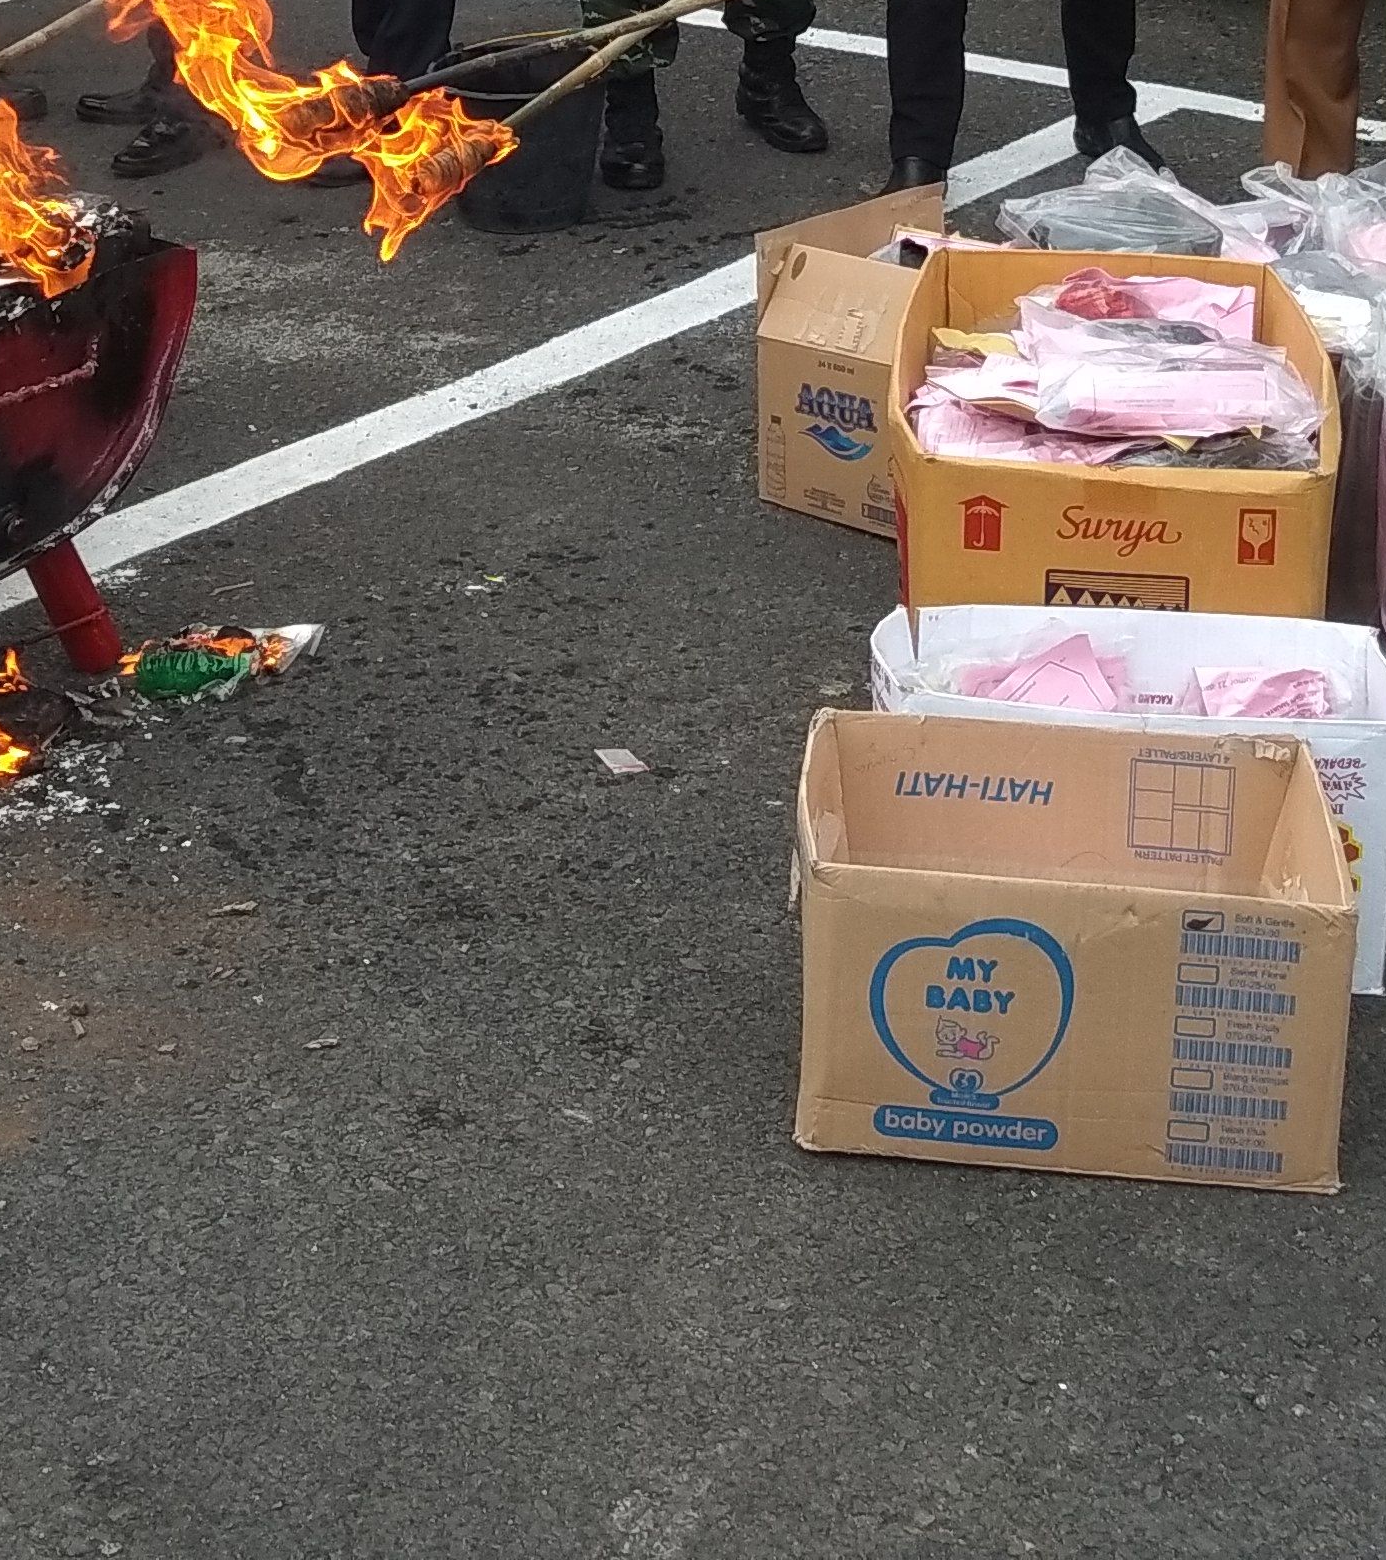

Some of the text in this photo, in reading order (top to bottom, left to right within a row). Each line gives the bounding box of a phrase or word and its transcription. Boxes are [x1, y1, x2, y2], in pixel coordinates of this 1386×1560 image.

[795, 382, 878, 434] AQUA
[1056, 505, 1182, 558] Surya
[1138, 747, 1221, 762] LAYERS/PALLET
[895, 771, 1054, 806] HATI-HATI
[1321, 780, 1353, 791] AWA
[1134, 849, 1224, 867] PALLET PATTERN
[947, 956, 998, 983] MY
[925, 984, 1015, 1015] BABY
[884, 1108, 1048, 1142] baby powder
